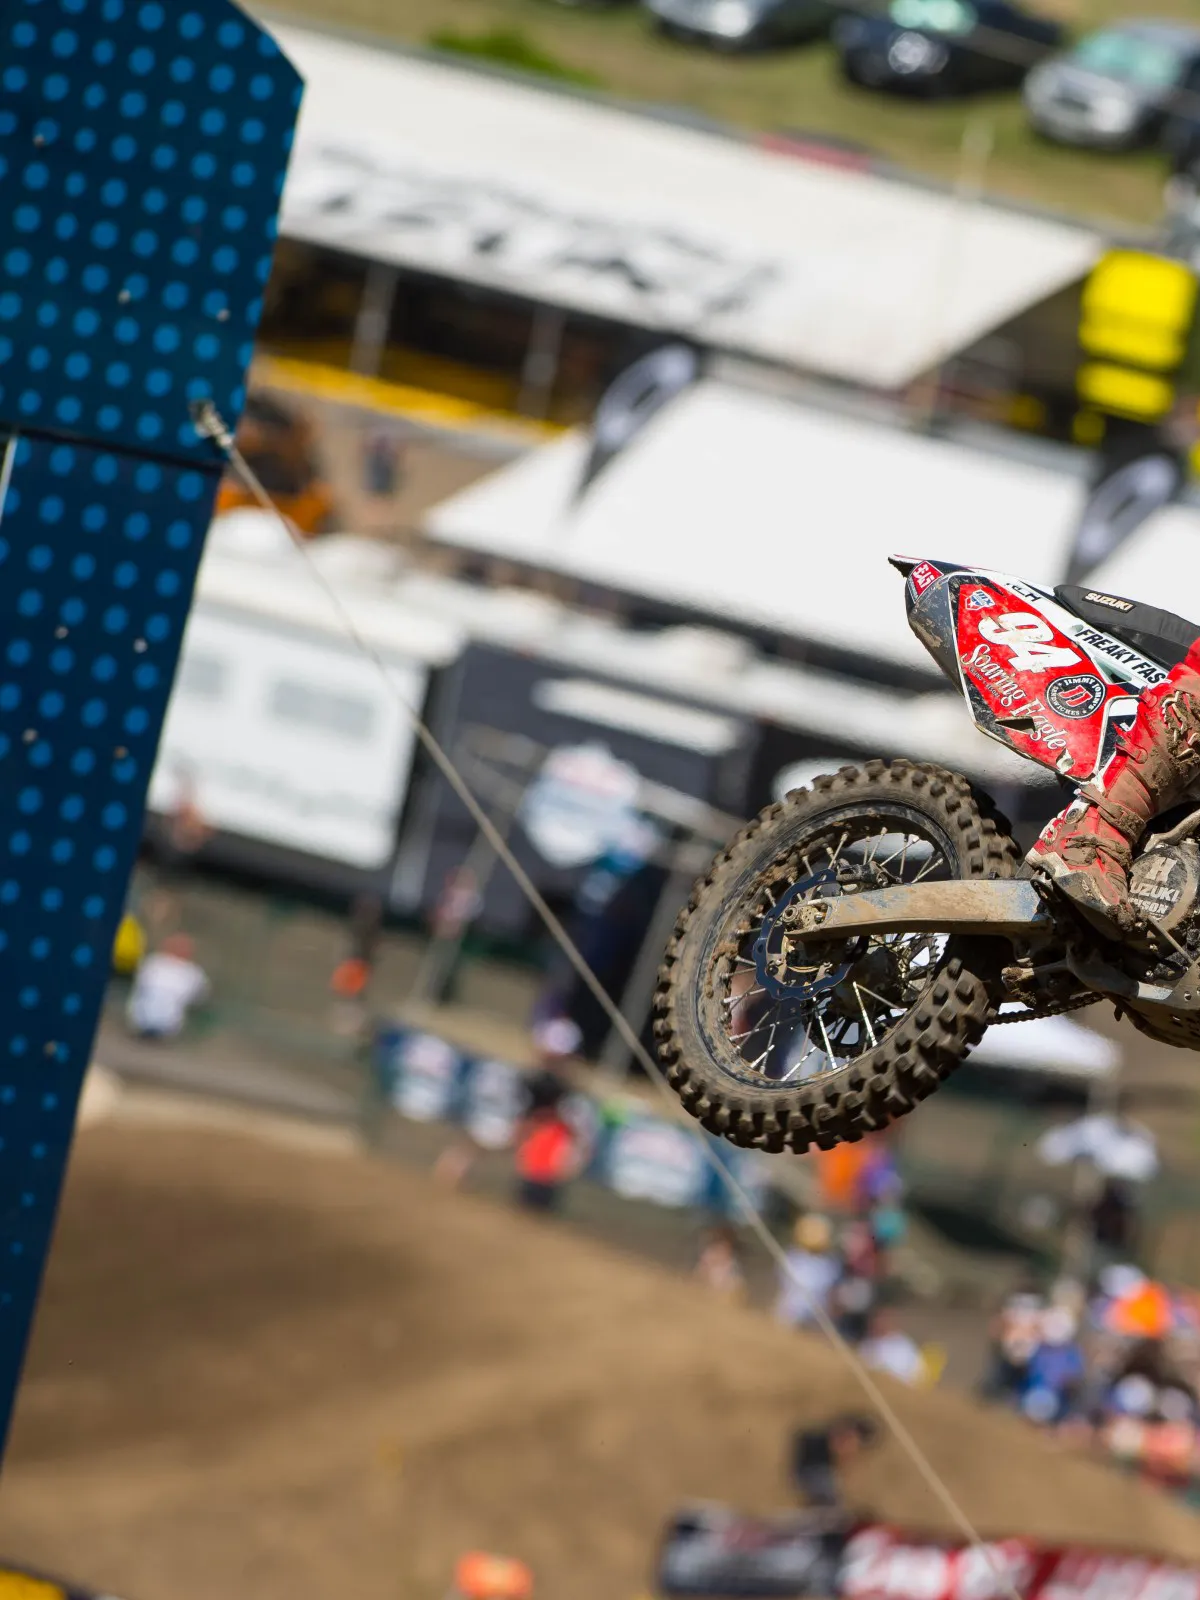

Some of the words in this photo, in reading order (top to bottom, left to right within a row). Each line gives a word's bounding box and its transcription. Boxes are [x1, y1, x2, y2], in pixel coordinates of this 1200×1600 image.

[1084, 592, 1134, 611] SUZUKI
[977, 611, 1083, 674] 94
[1074, 628, 1142, 665] FREAKY
[1131, 661, 1167, 684] FAS
[960, 643, 1027, 707] Soaring
[1009, 697, 1068, 750] Eagle
[1063, 678, 1095, 686] JIMMY
[1129, 881, 1180, 903] UZUKI
